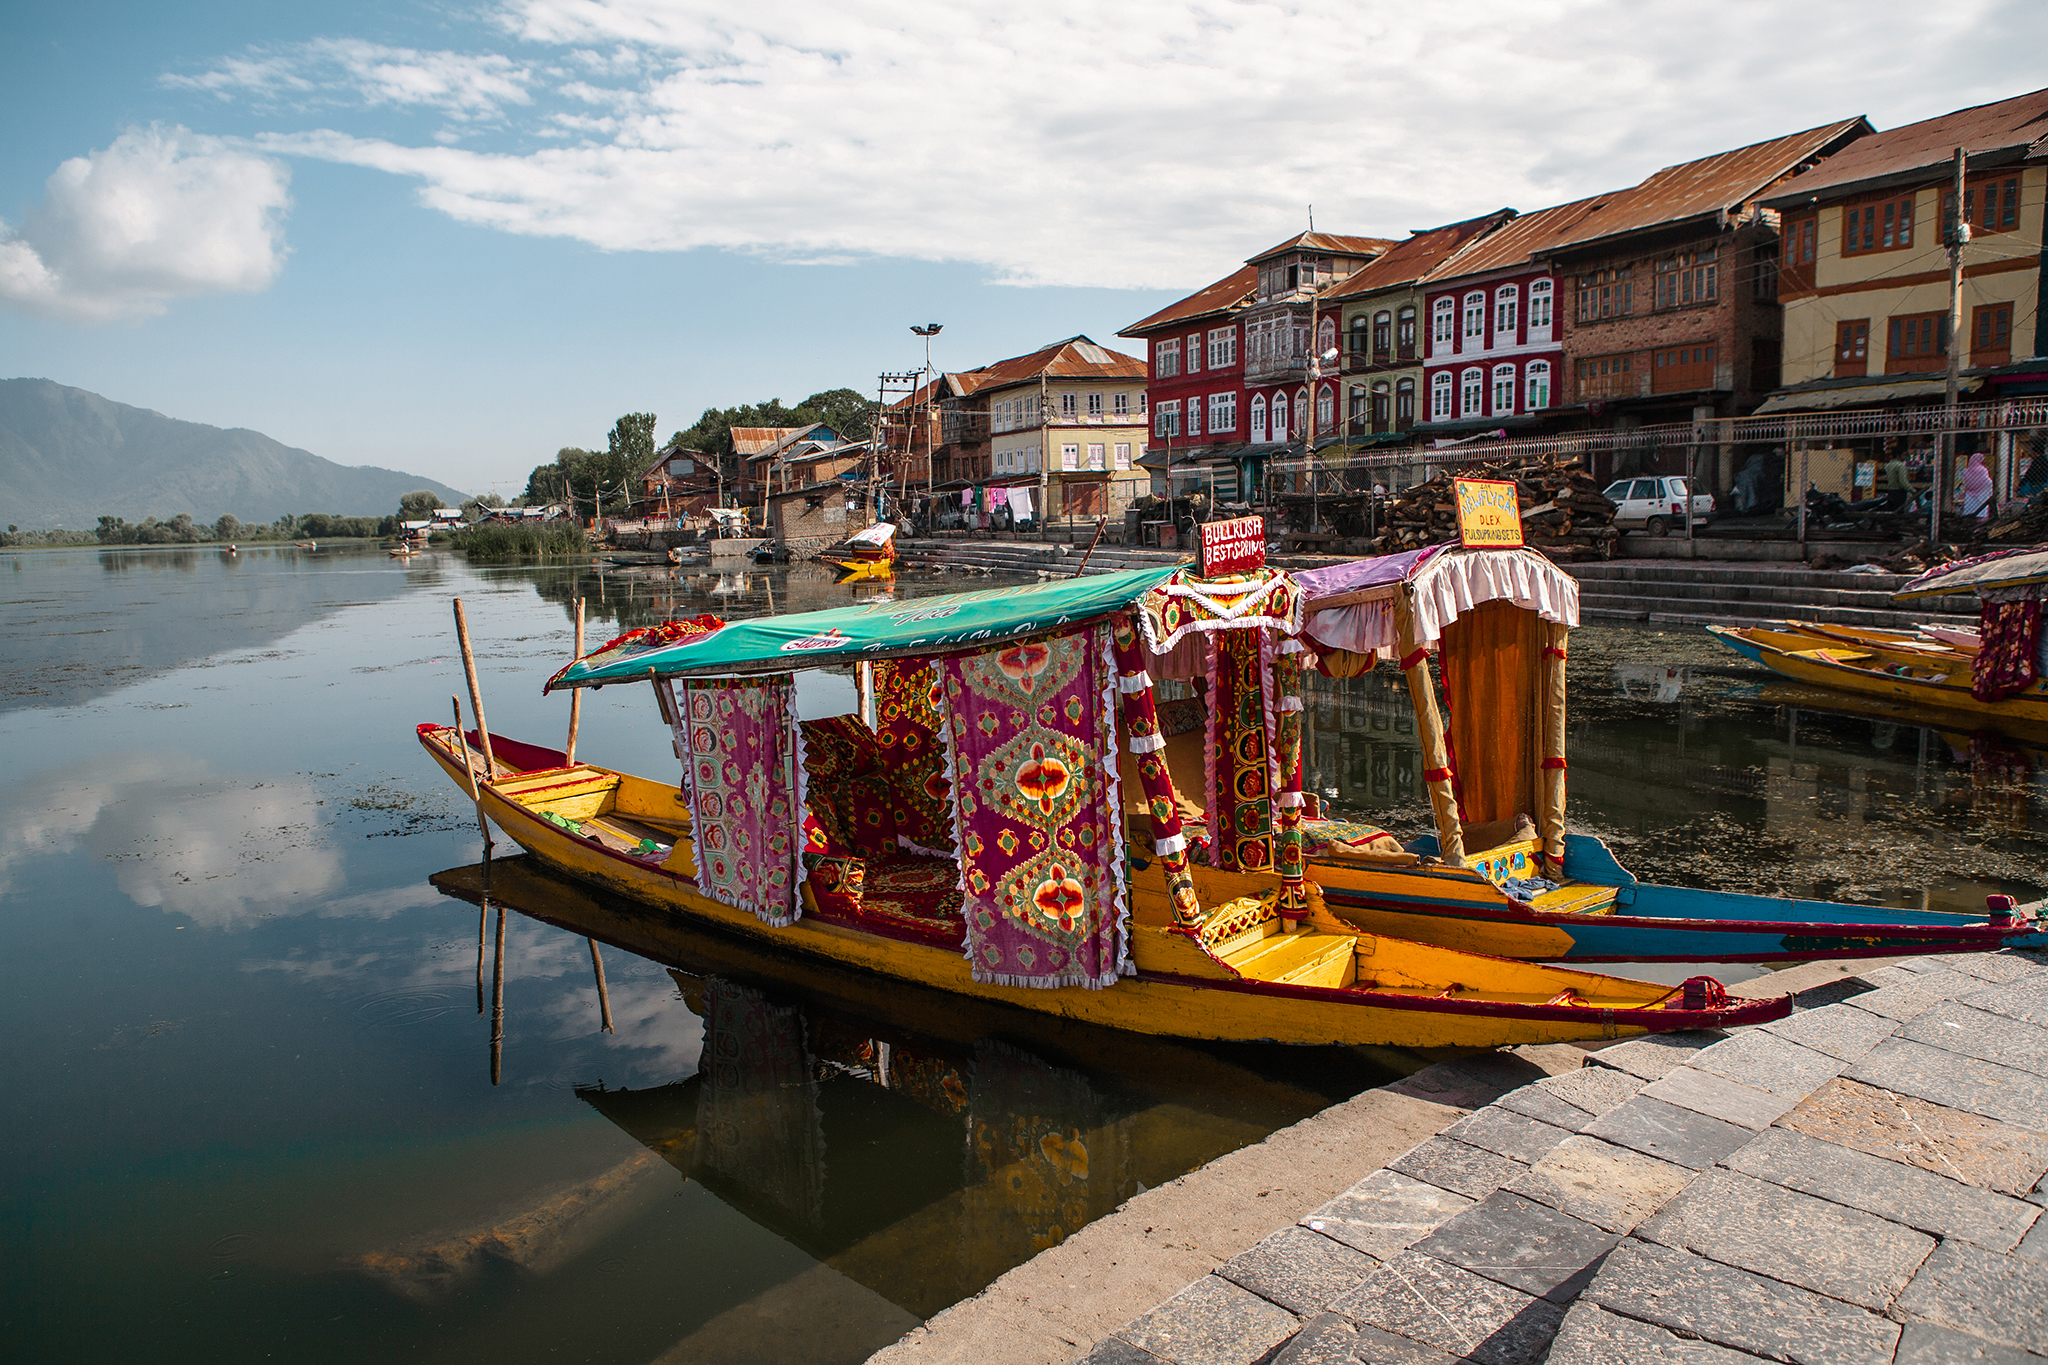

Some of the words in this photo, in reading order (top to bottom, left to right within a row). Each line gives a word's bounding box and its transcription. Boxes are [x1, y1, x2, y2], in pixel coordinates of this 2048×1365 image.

[1204, 518, 1262, 546] BULLRUSH
[1479, 515, 1502, 526] DLEX
[889, 604, 962, 627] Tea
